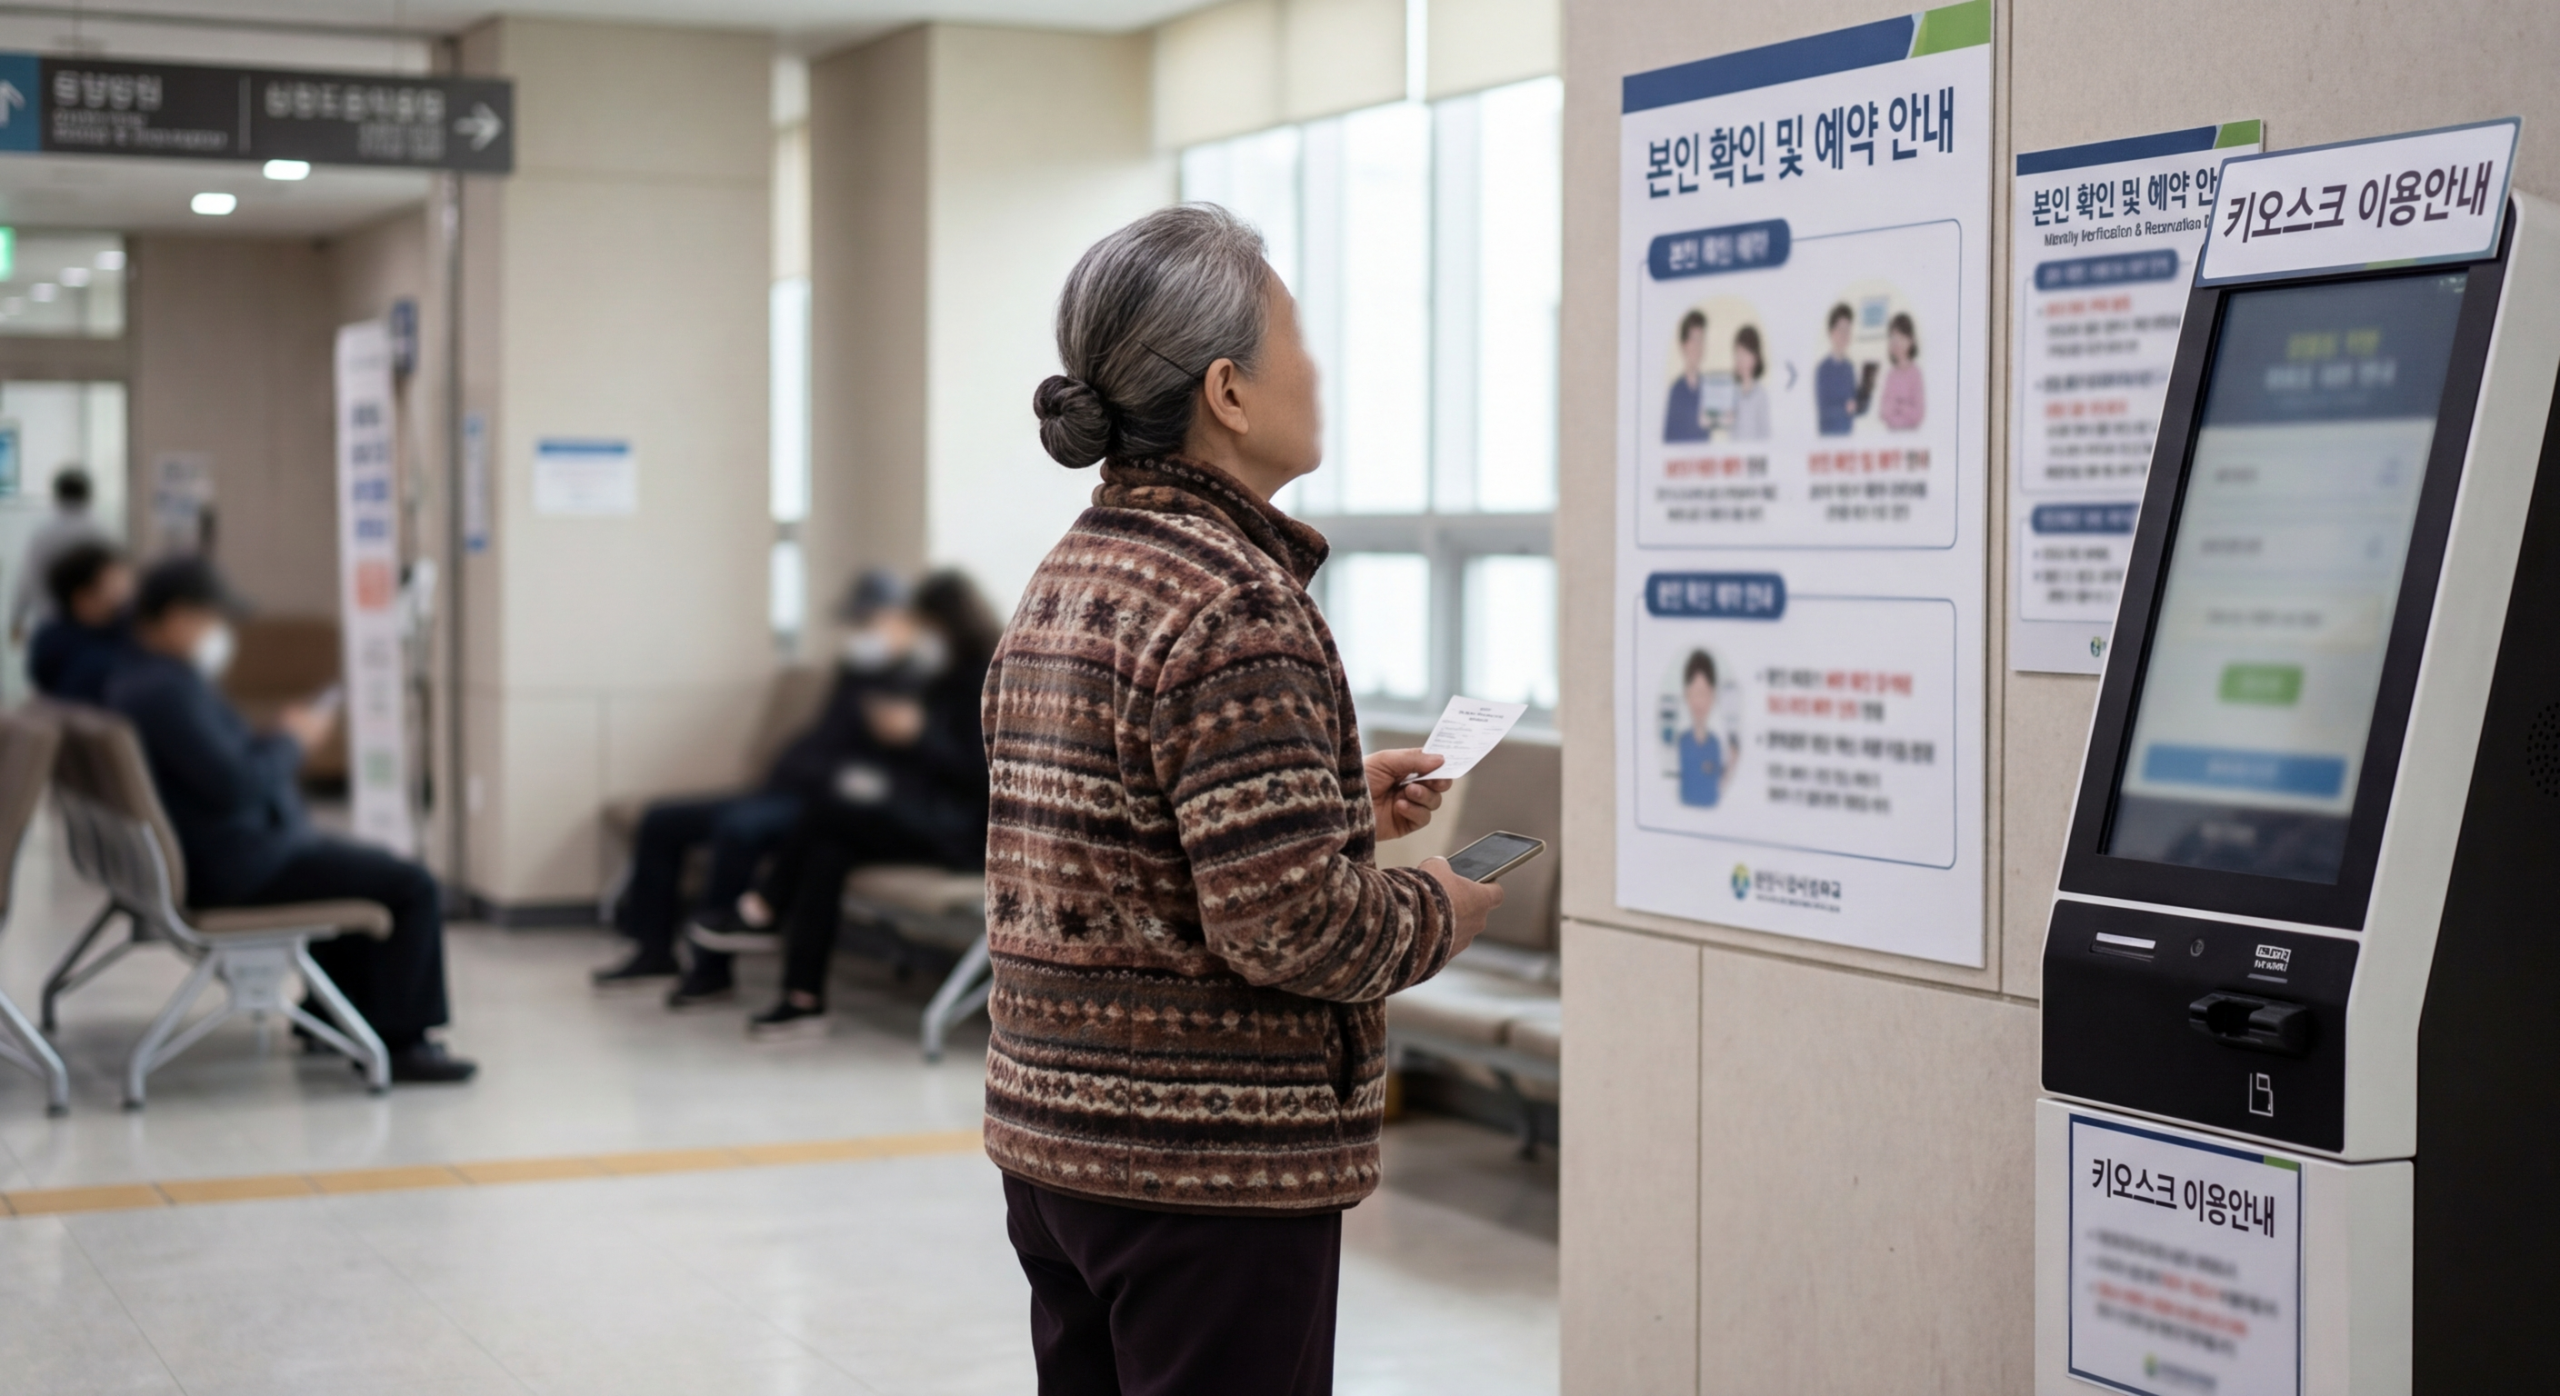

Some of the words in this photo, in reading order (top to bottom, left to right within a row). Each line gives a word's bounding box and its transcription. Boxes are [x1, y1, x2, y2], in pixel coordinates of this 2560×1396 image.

[1646, 133, 1699, 199] 본인
[1709, 121, 1765, 188] 확인
[1776, 114, 1804, 180] 및
[1814, 100, 1879, 171] 예약
[1888, 85, 1954, 162] 안내
[2032, 186, 2070, 227] 본인
[2075, 180, 2115, 221] 확인
[2122, 176, 2141, 216] 및
[2195, 166, 2218, 207] 안
[2135, 222, 2142, 237] &
[2222, 183, 2348, 244] 키오스크
[2358, 160, 2494, 229] 이용안내
[2092, 1158, 2178, 1210] 키오스크
[2183, 1179, 2275, 1239] 이용안내
